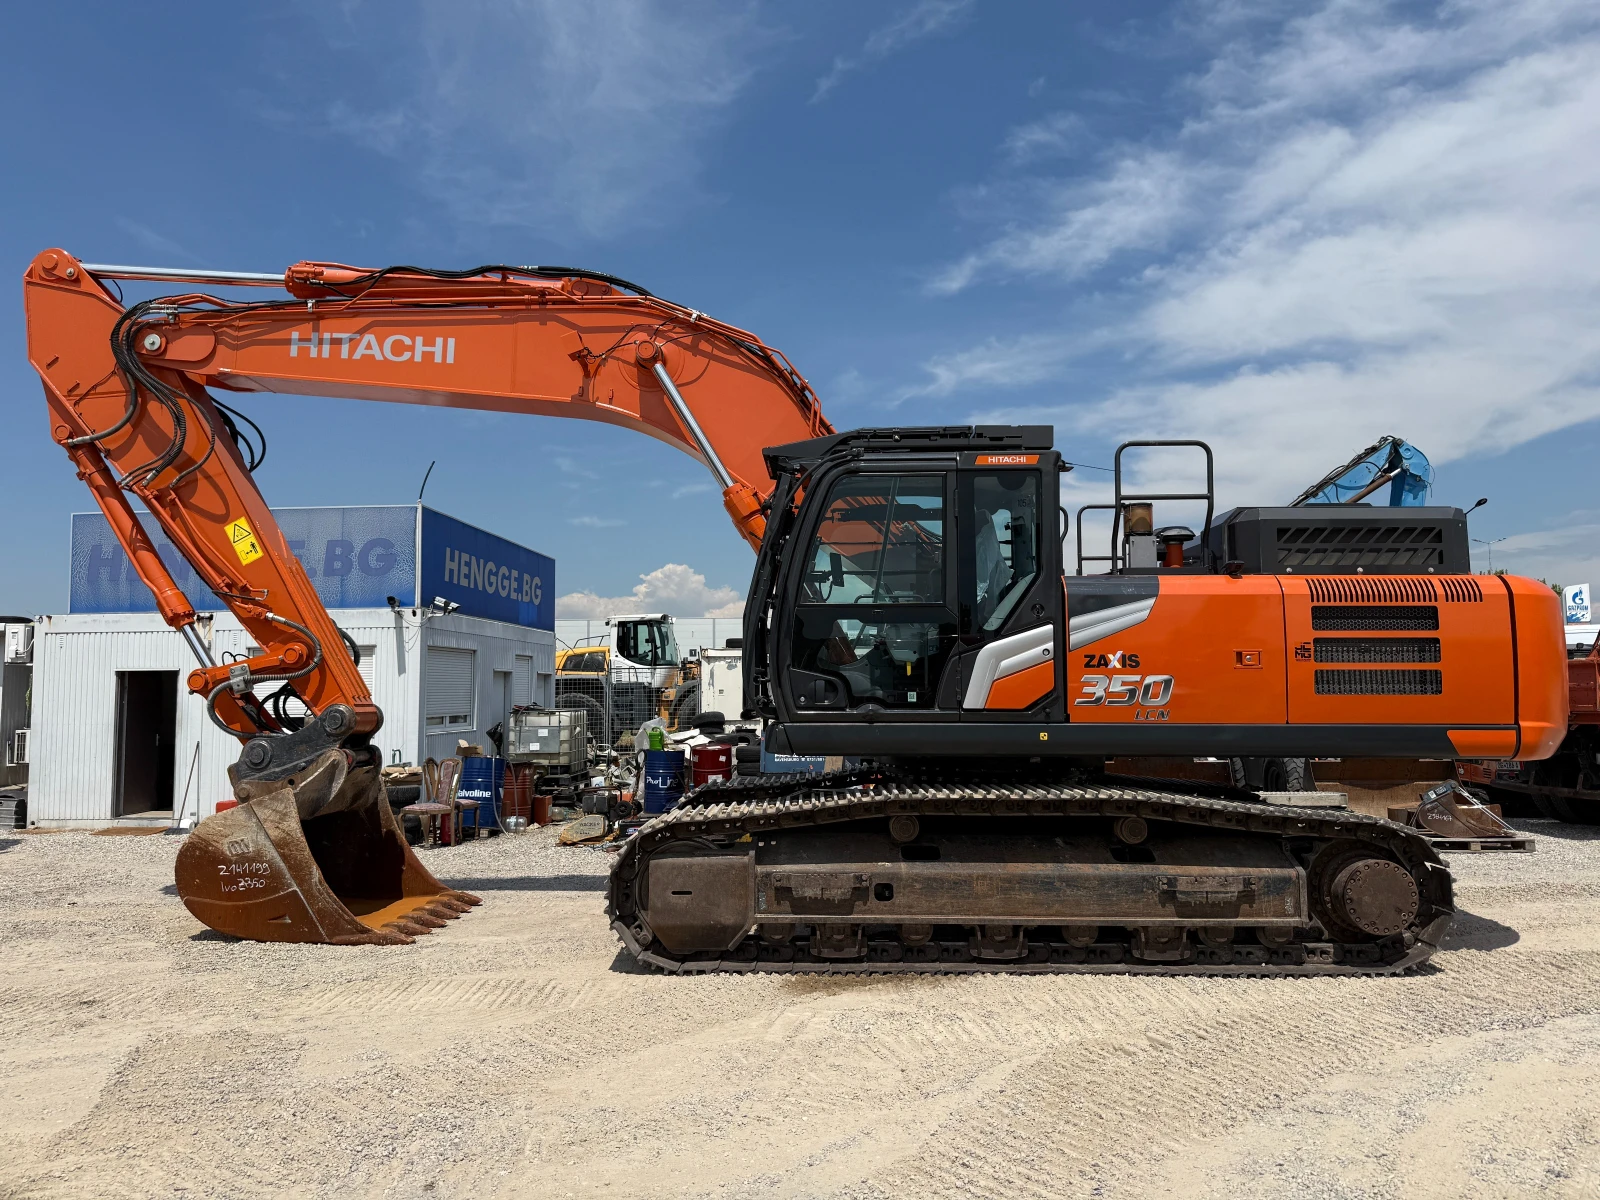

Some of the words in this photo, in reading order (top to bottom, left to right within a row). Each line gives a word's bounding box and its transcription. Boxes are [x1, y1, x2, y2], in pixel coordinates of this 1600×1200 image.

[289, 331, 456, 364] HITACHI
[444, 546, 542, 606] HENGGE.BG
[1083, 650, 1141, 669] ZAXIS
[1073, 674, 1175, 706] 350
[1133, 708, 1170, 721] LCN
[458, 789, 492, 798] alvoline
